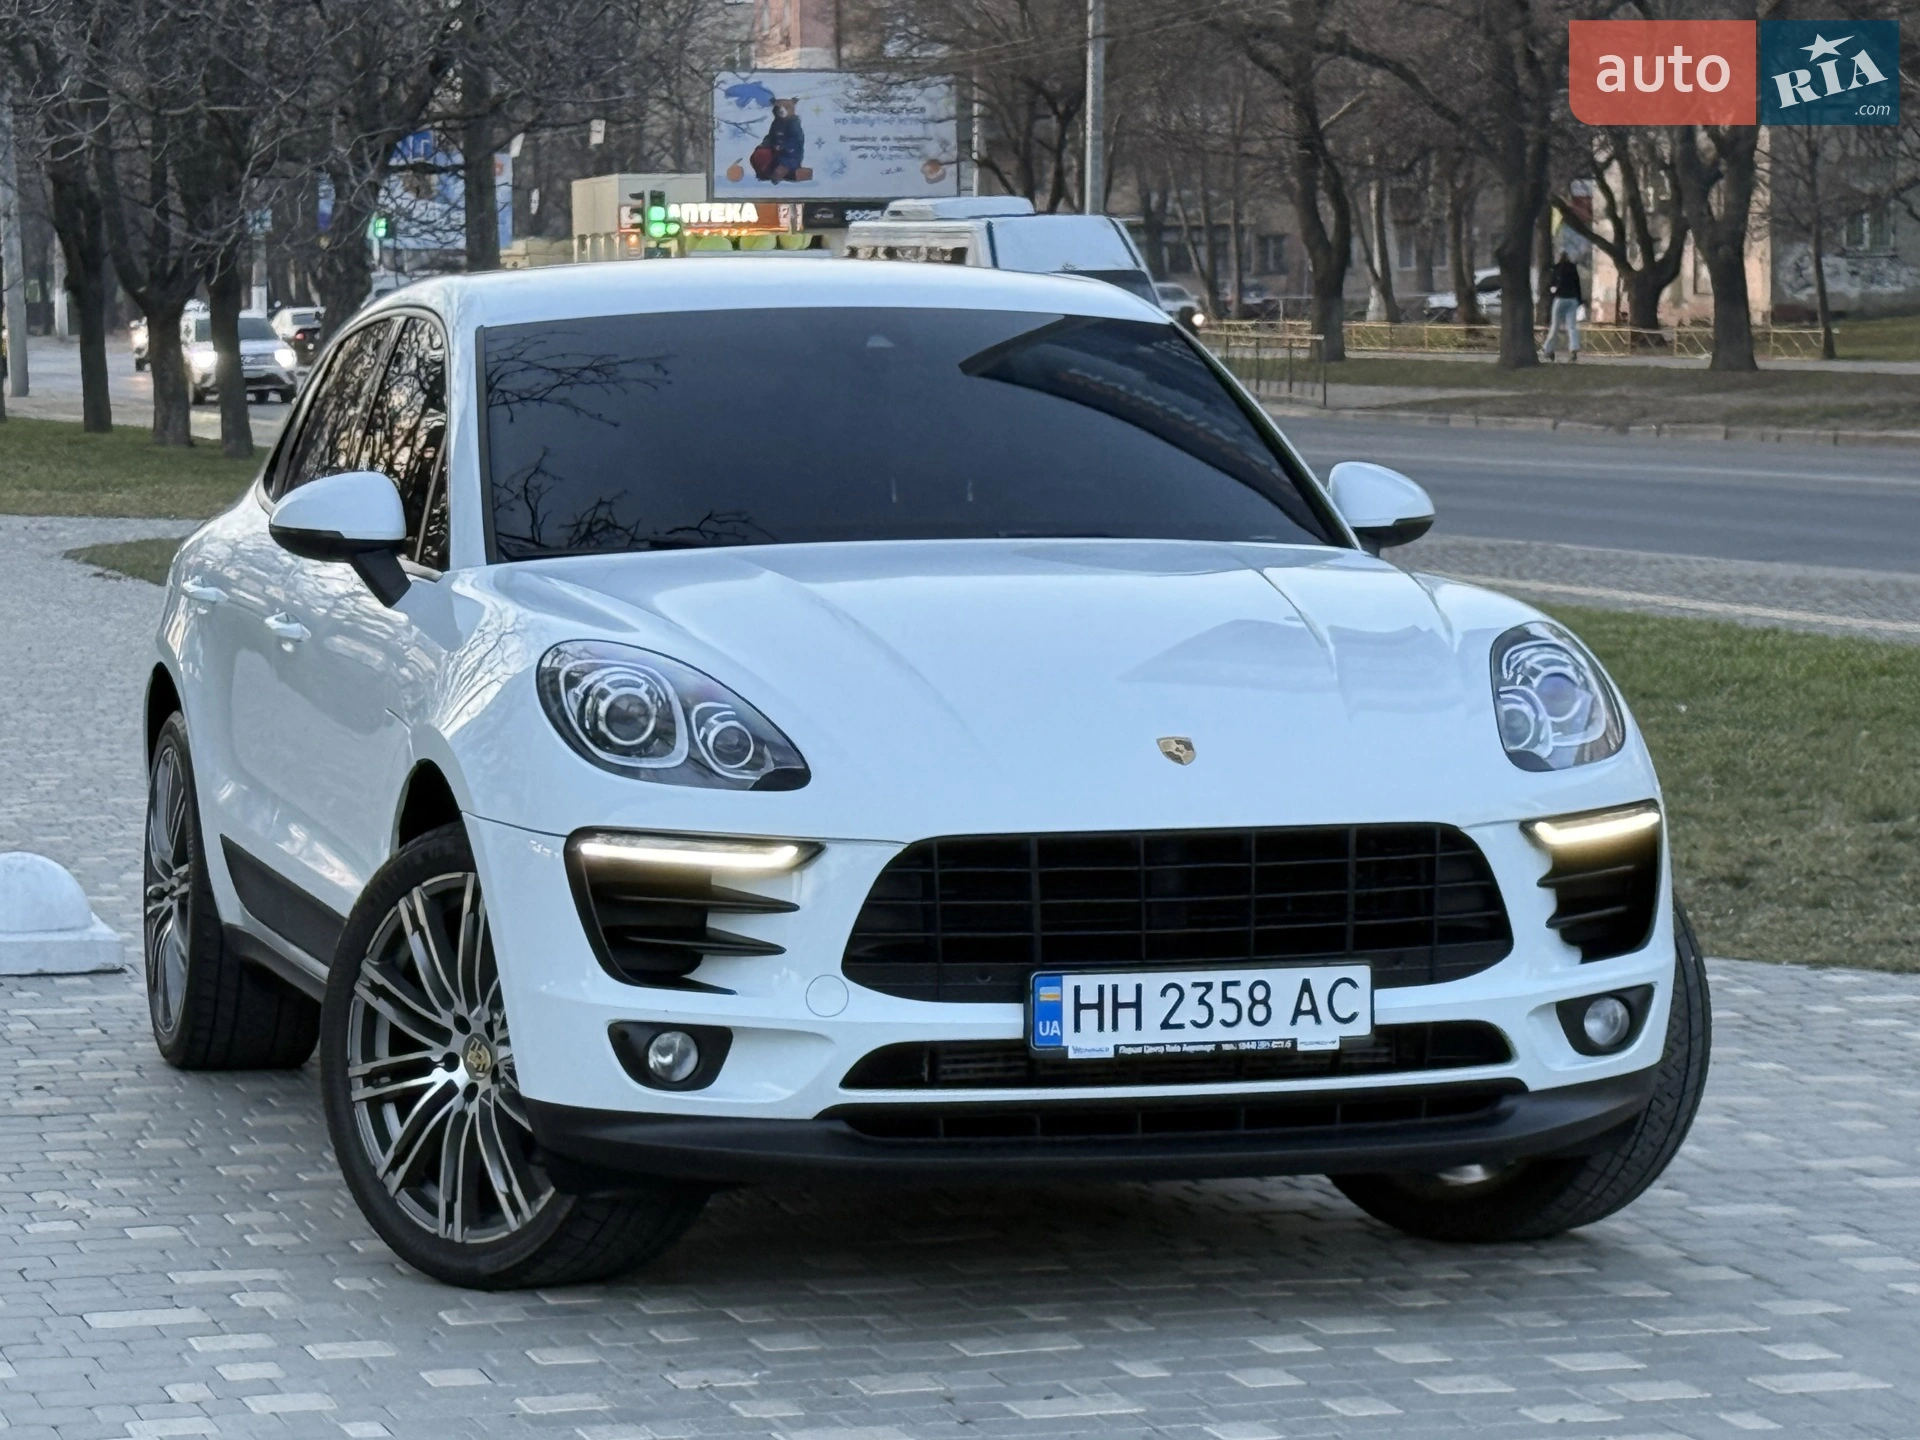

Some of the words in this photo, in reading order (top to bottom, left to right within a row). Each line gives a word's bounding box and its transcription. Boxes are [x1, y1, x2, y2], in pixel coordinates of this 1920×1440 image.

[1073, 983, 1143, 1034] HH
[1159, 978, 1272, 1030] 2358
[1289, 976, 1360, 1027] AC
[1038, 1020, 1062, 1037] UA
